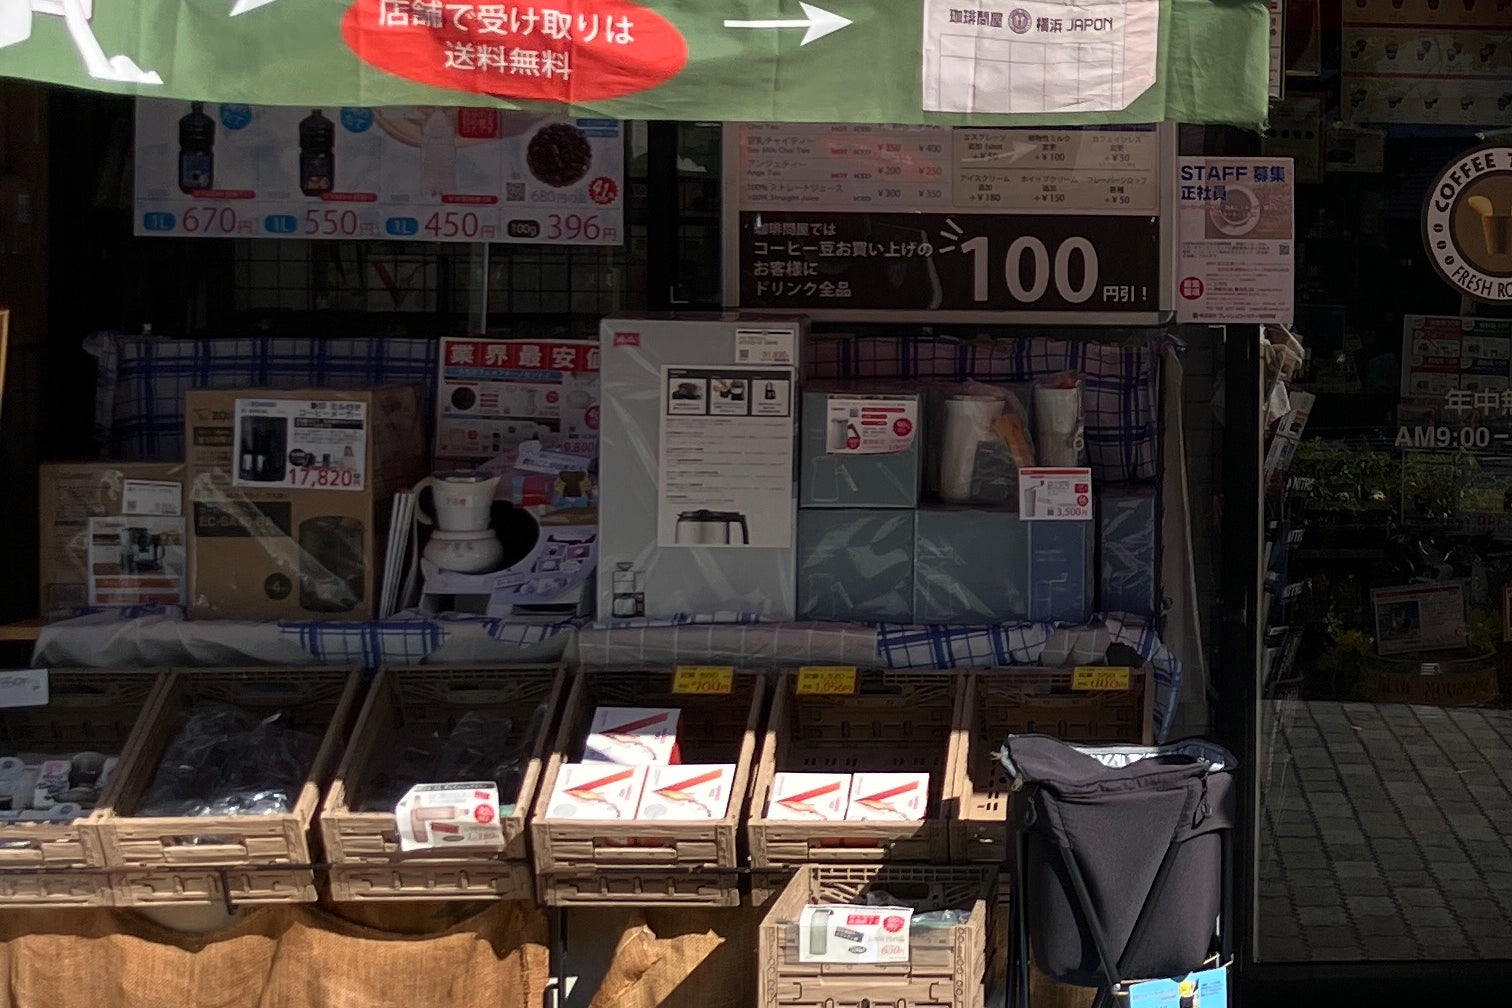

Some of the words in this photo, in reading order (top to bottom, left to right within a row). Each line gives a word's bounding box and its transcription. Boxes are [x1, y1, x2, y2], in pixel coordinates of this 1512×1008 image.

[378, 0, 635, 44] 店舗で受け取りは
[949, 8, 1003, 28] 珈琲問屋
[1036, 17, 1063, 33] 横浜
[1066, 17, 1113, 32] JAPON
[445, 41, 572, 80] 送料無料
[1180, 165, 1248, 181] STAFF
[1253, 165, 1286, 183] 募集
[1435, 152, 1497, 213] COFFEE
[1180, 184, 1227, 201] 正社員
[753, 241, 934, 258] コーヒー豆お買い上げの
[753, 261, 818, 277] お客様に
[961, 235, 1098, 304] 100
[1451, 265, 1494, 297] FRESH
[754, 280, 853, 298] ドリンク全品
